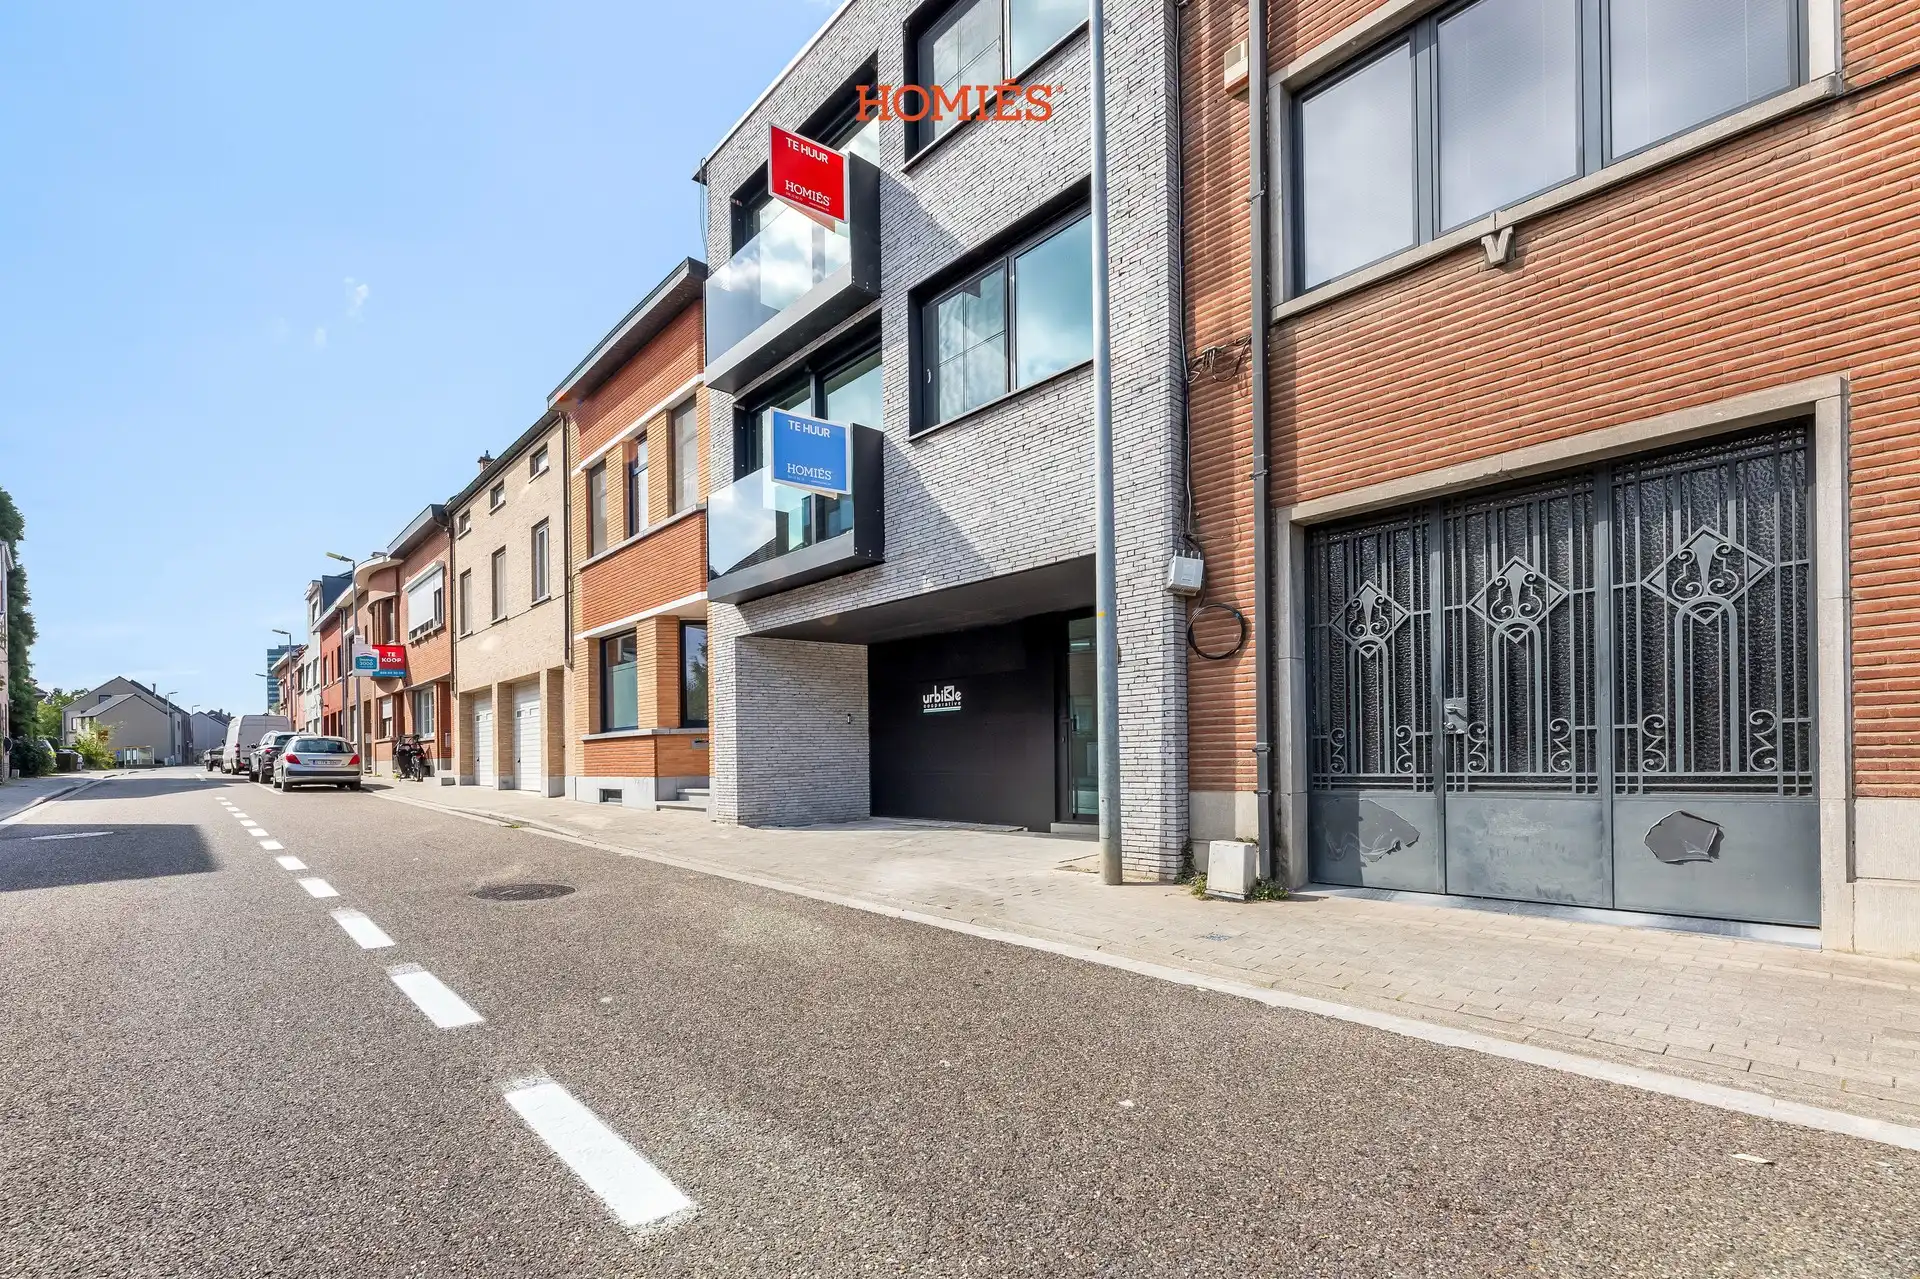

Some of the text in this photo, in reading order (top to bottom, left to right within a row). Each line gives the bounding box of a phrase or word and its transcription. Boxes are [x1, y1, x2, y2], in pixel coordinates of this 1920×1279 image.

[785, 136, 829, 164] TE HUUR
[788, 419, 831, 438] TE HUUR
